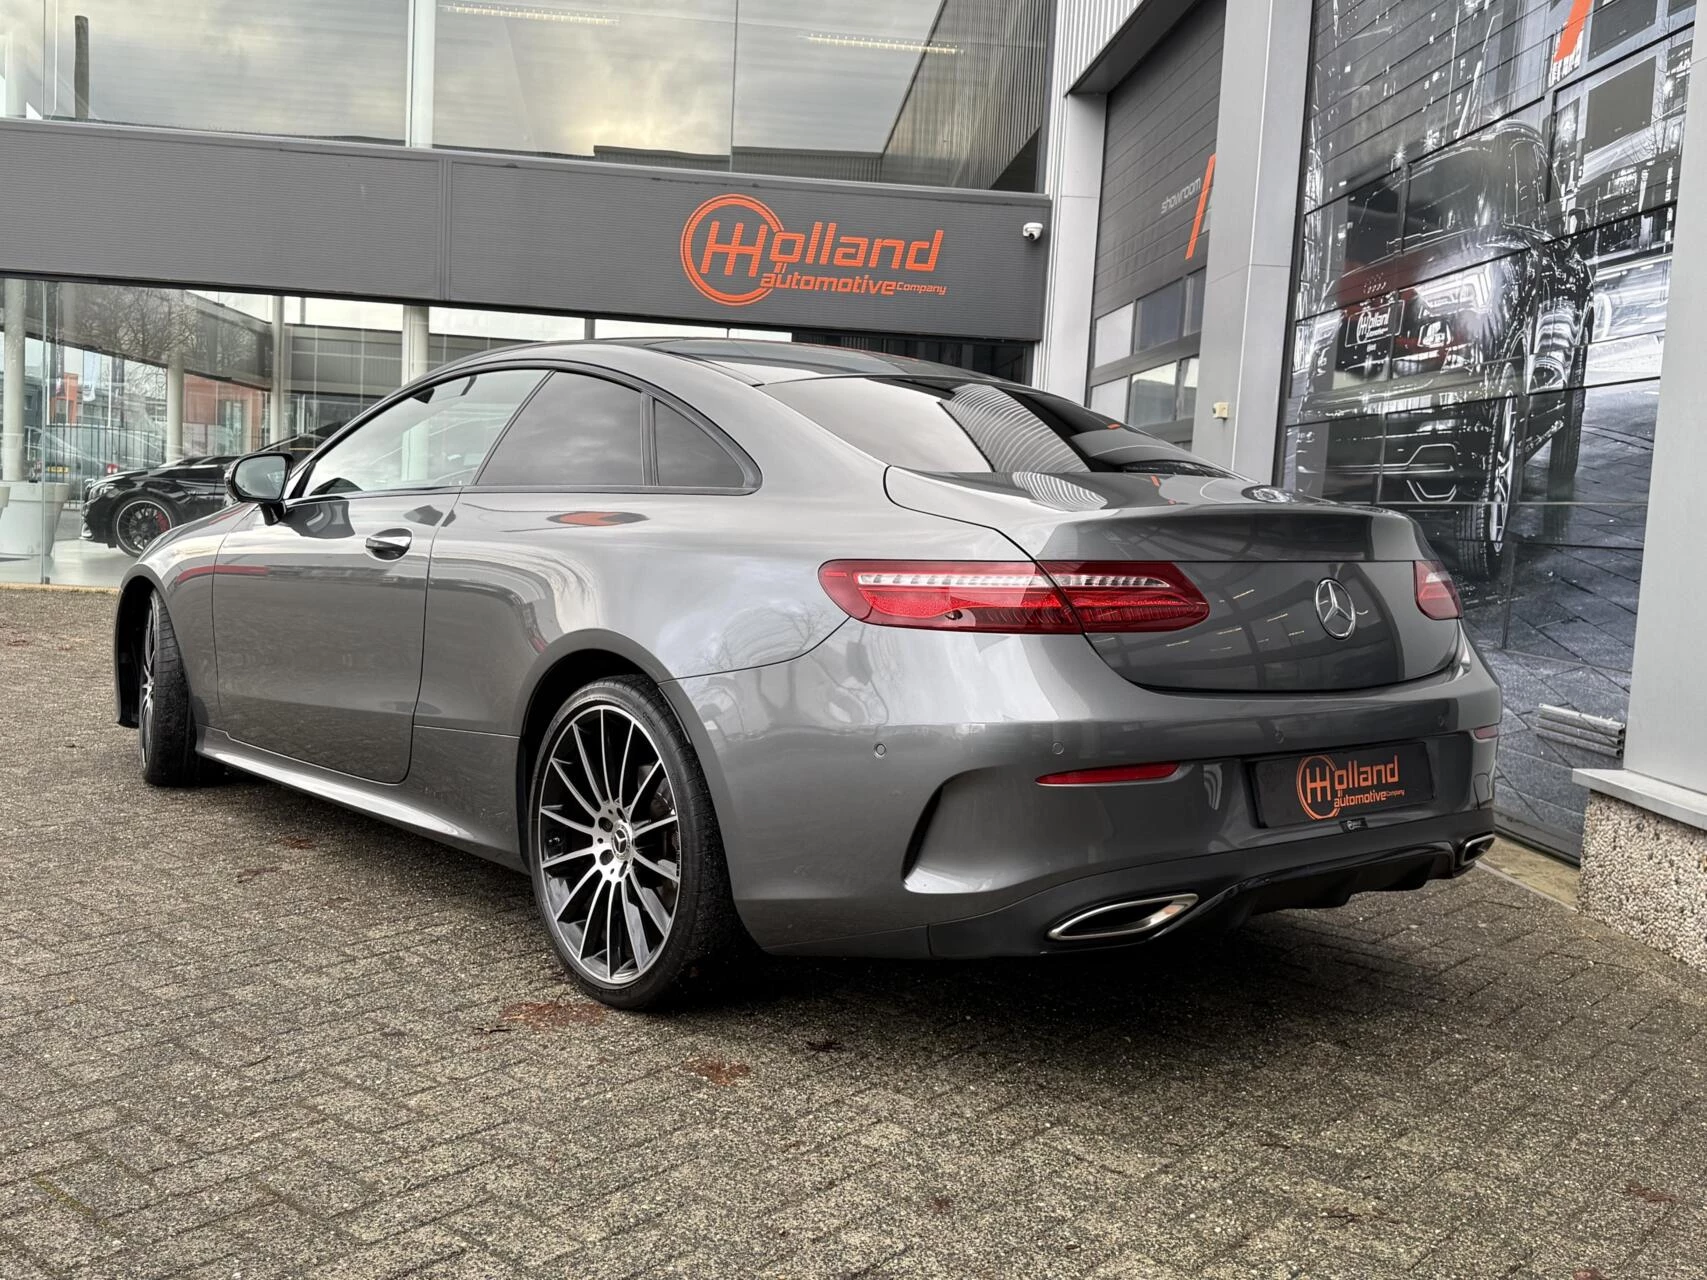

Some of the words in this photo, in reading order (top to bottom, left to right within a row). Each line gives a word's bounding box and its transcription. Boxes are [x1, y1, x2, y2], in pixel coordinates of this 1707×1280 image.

[1160, 177, 1201, 214] showroom
[700, 220, 944, 277] Holland
[760, 272, 896, 295] automotive
[896, 281, 947, 295] Company
[1306, 755, 1399, 804] Holland
[1334, 789, 1387, 808] automotive
